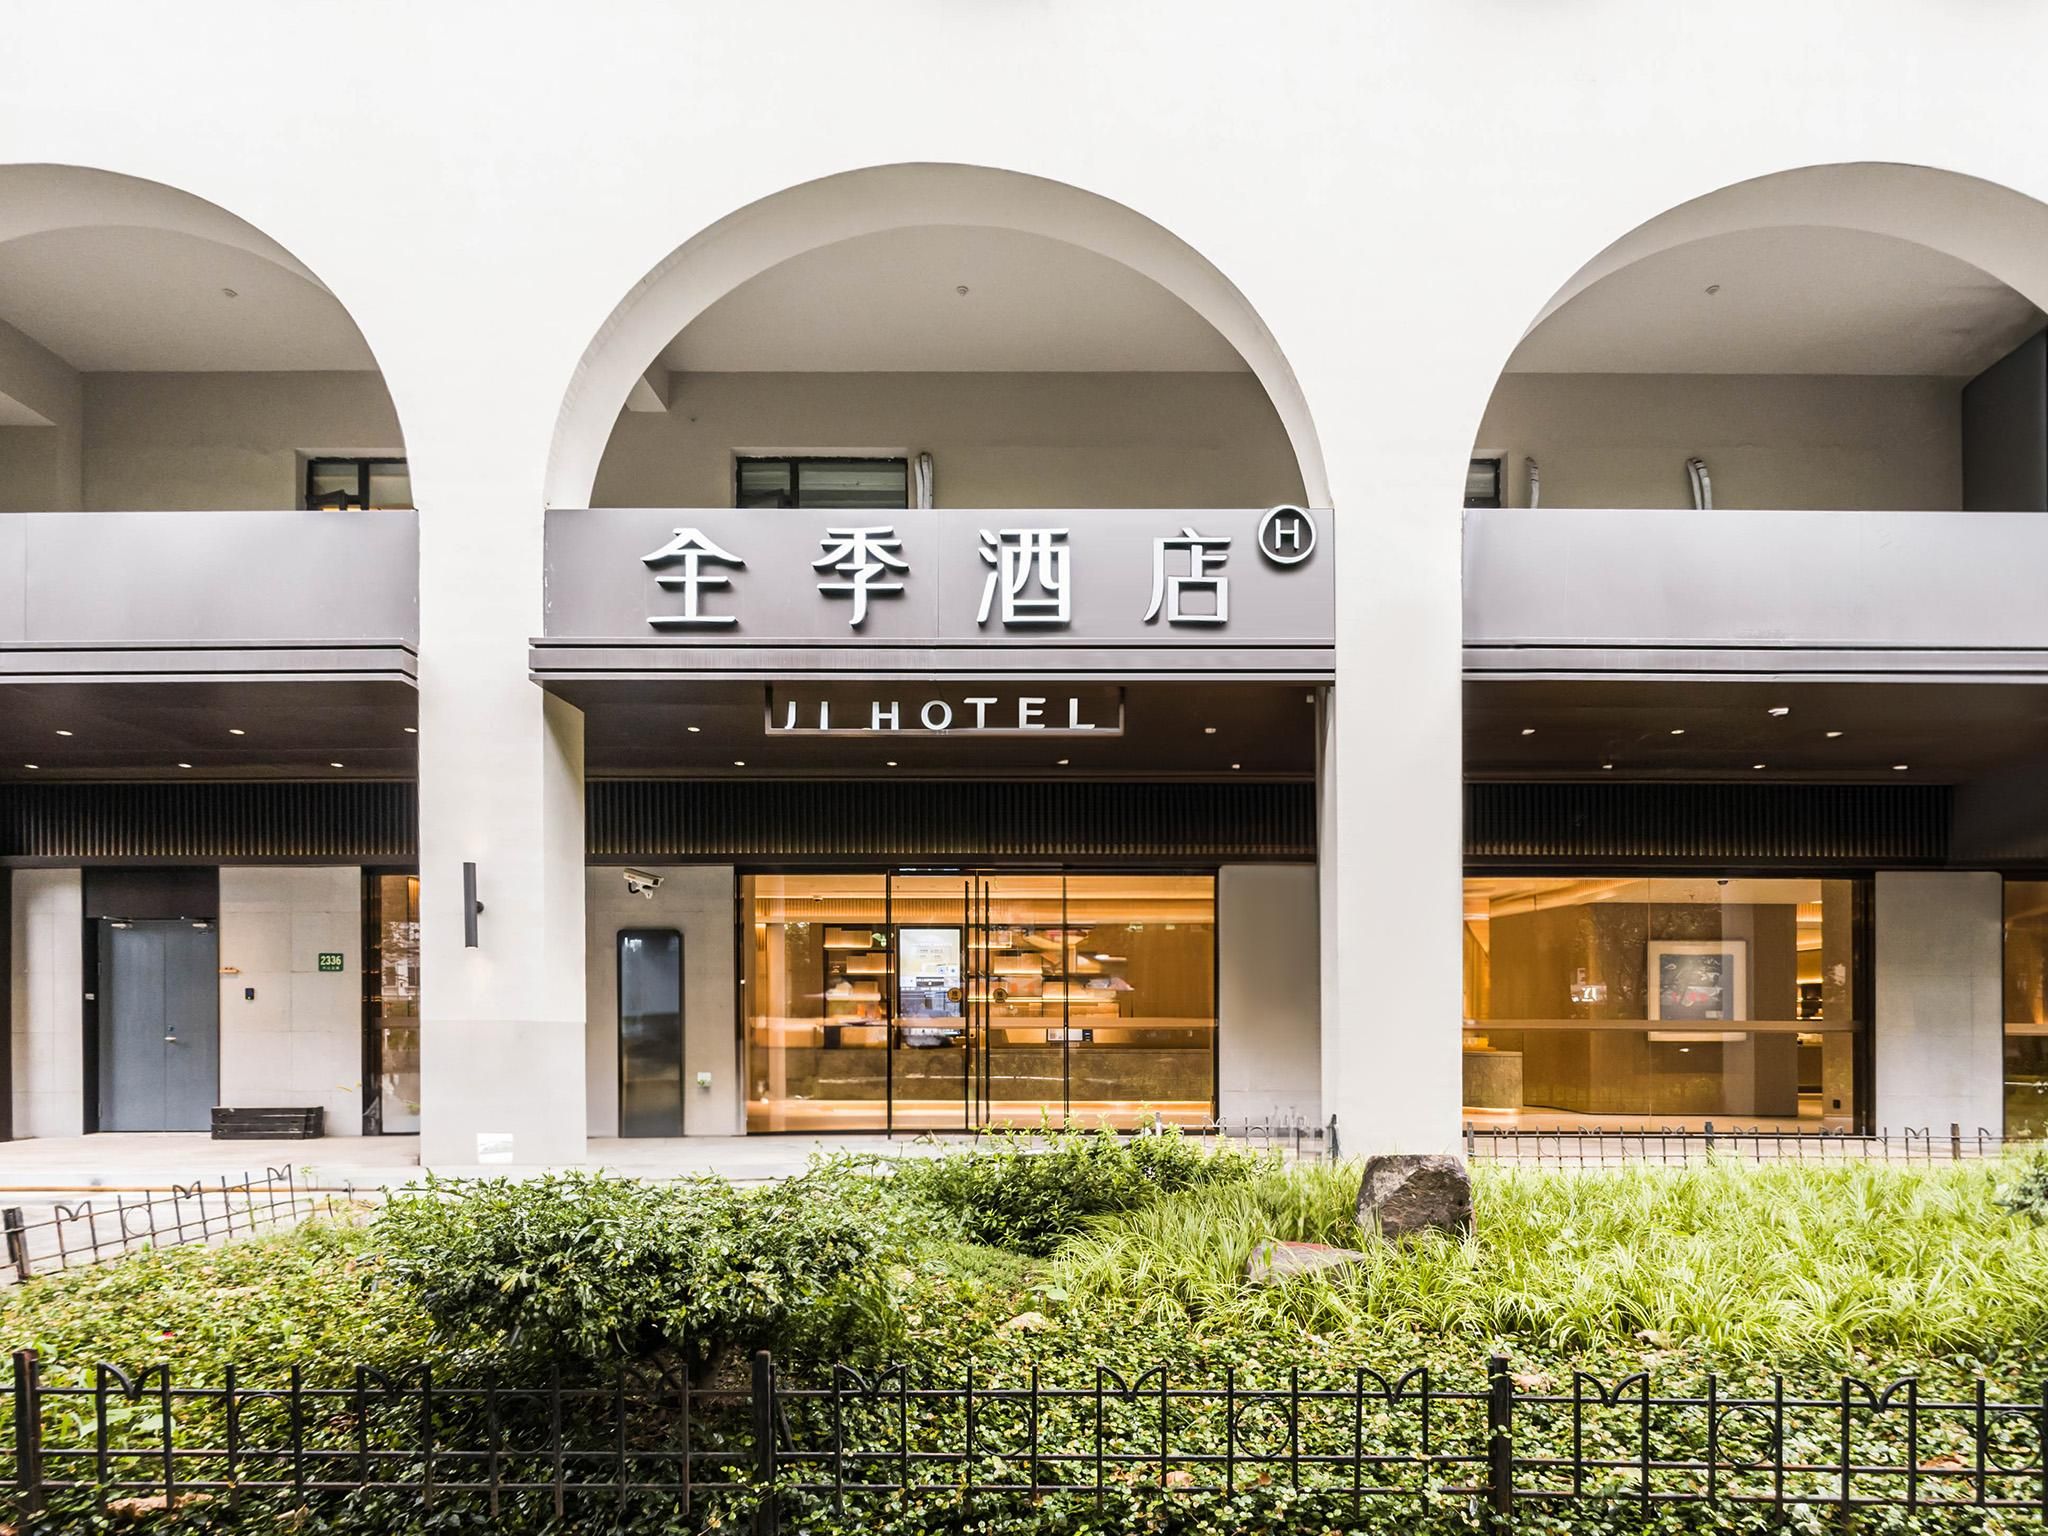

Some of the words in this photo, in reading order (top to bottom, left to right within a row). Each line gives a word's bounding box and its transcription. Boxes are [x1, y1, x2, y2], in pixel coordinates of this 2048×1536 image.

[640, 524, 1232, 629] 全季酒店
[783, 700, 829, 731] JI
[871, 697, 1096, 731] HOTEL
[320, 955, 342, 966] 2336
